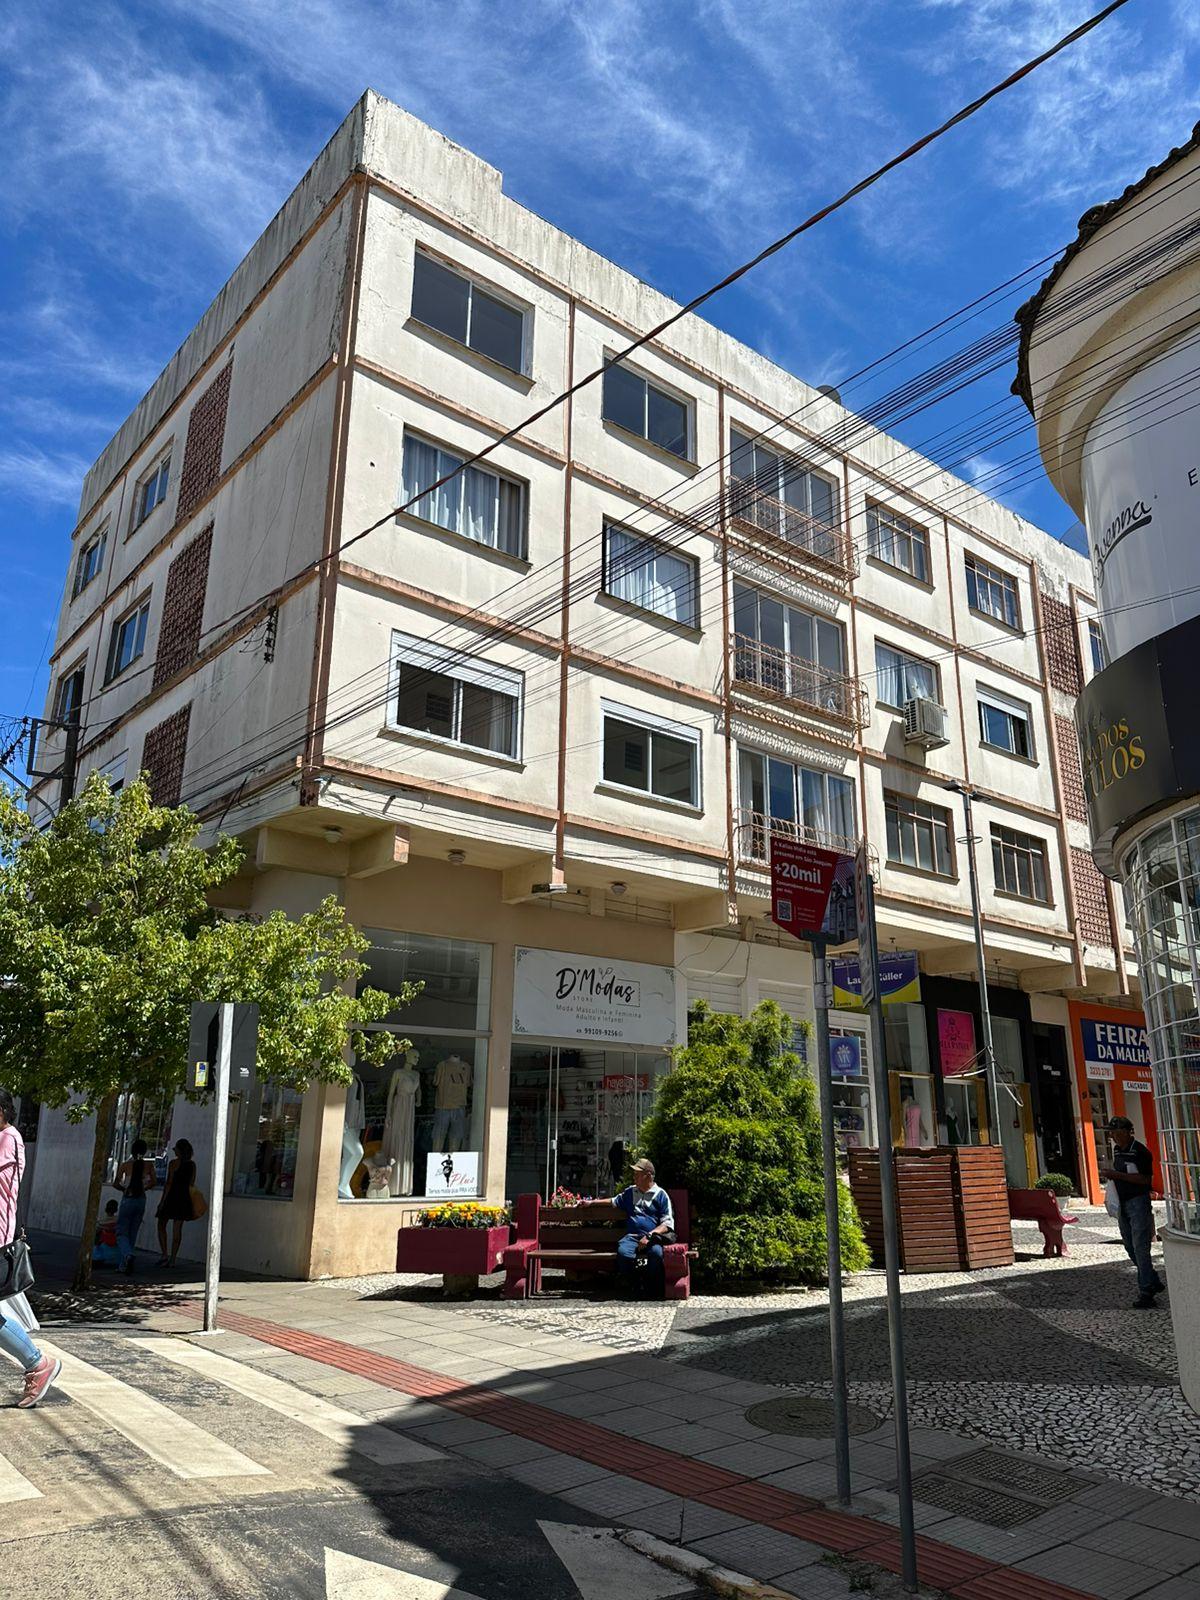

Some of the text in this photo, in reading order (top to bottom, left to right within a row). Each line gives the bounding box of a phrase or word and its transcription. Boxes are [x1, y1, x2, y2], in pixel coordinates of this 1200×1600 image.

[775, 862, 821, 885] +20mil
[556, 967, 635, 1004] D'Modas
[556, 1004, 574, 1012] Moda
[576, 1005, 607, 1016] Masculina
[615, 1008, 642, 1019] Feminina
[576, 1014, 596, 1022] Adulto
[1094, 1023, 1149, 1047] FEIRA
[1097, 1044, 1115, 1060] DA
